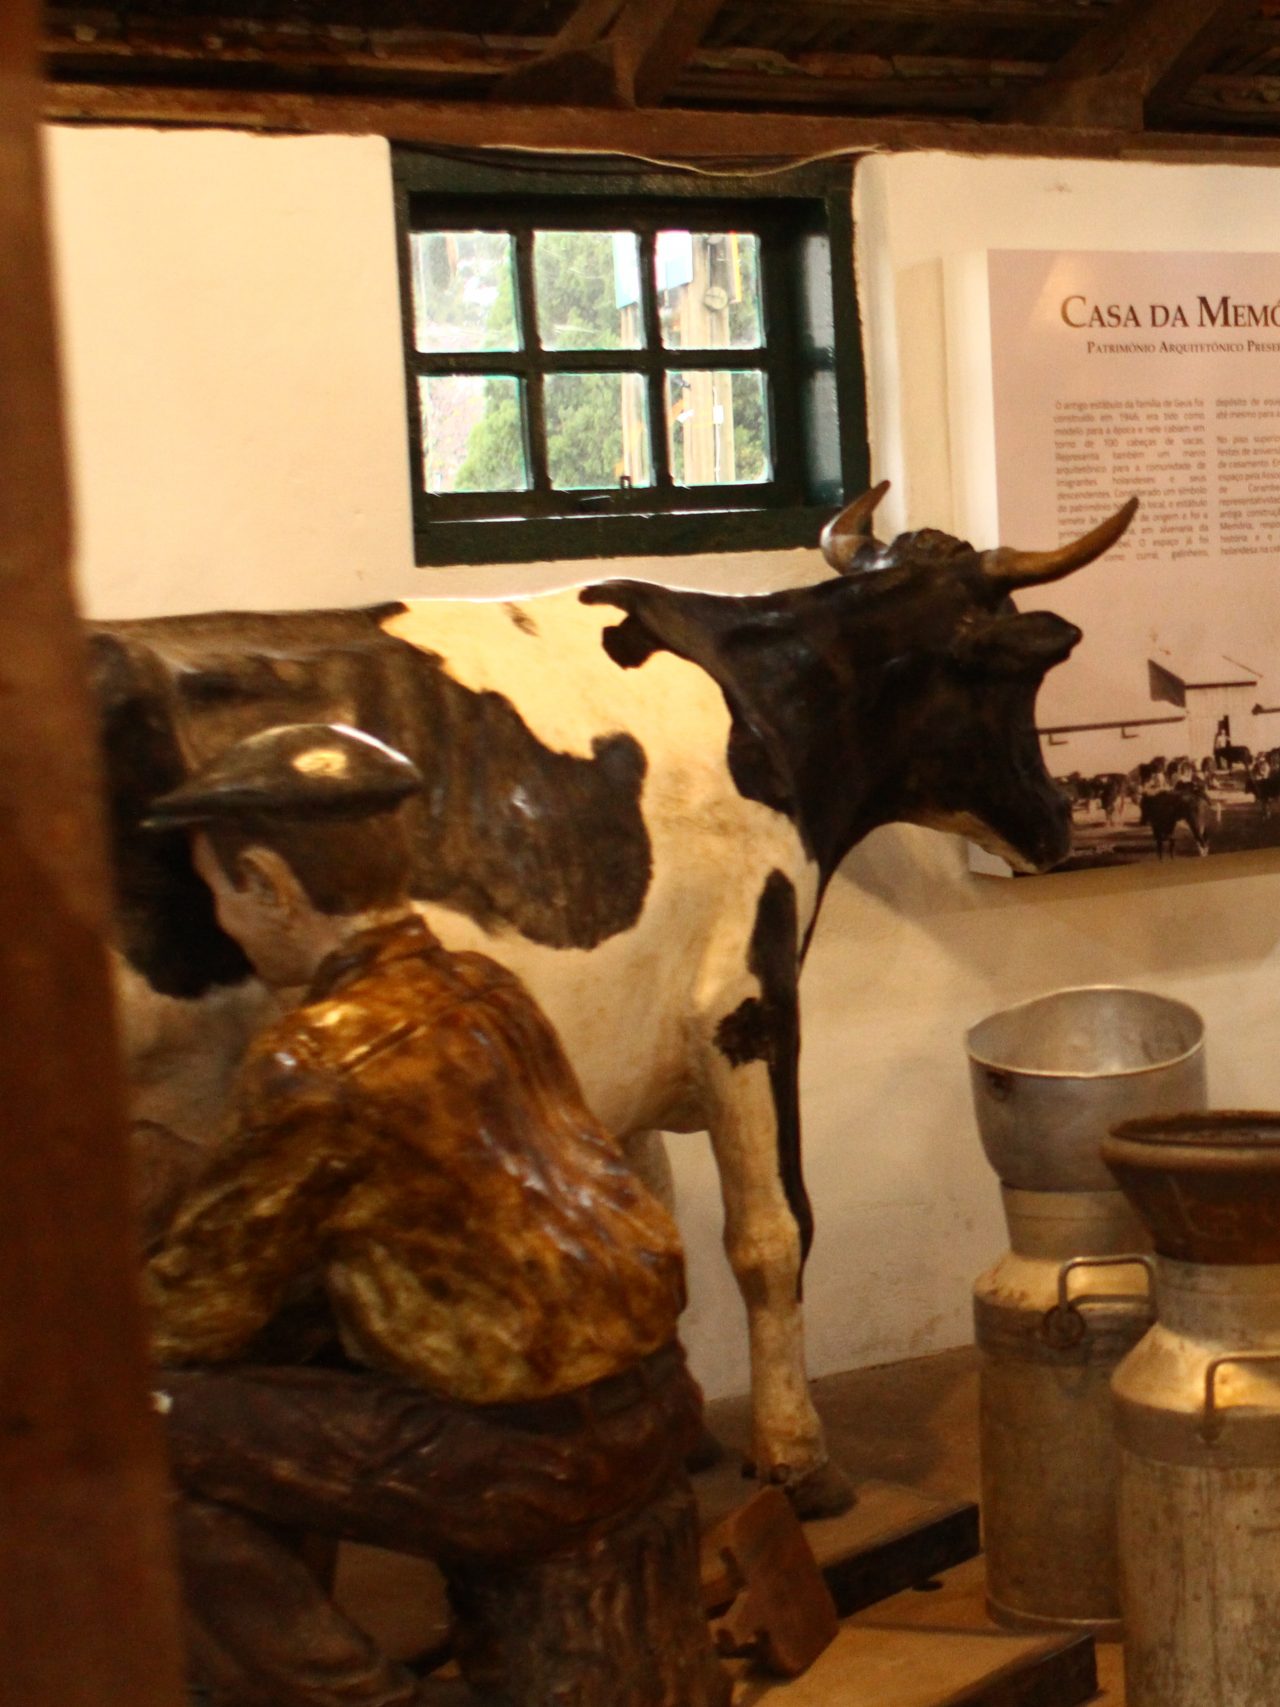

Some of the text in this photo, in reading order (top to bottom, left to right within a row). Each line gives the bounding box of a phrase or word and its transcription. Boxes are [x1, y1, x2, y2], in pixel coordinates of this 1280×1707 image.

[1060, 295, 1141, 329] CASA
[1150, 304, 1189, 328] DA
[1087, 340, 1155, 354] PATRIMÔNIO
[1159, 340, 1244, 354] ARQUITETÔNICO
